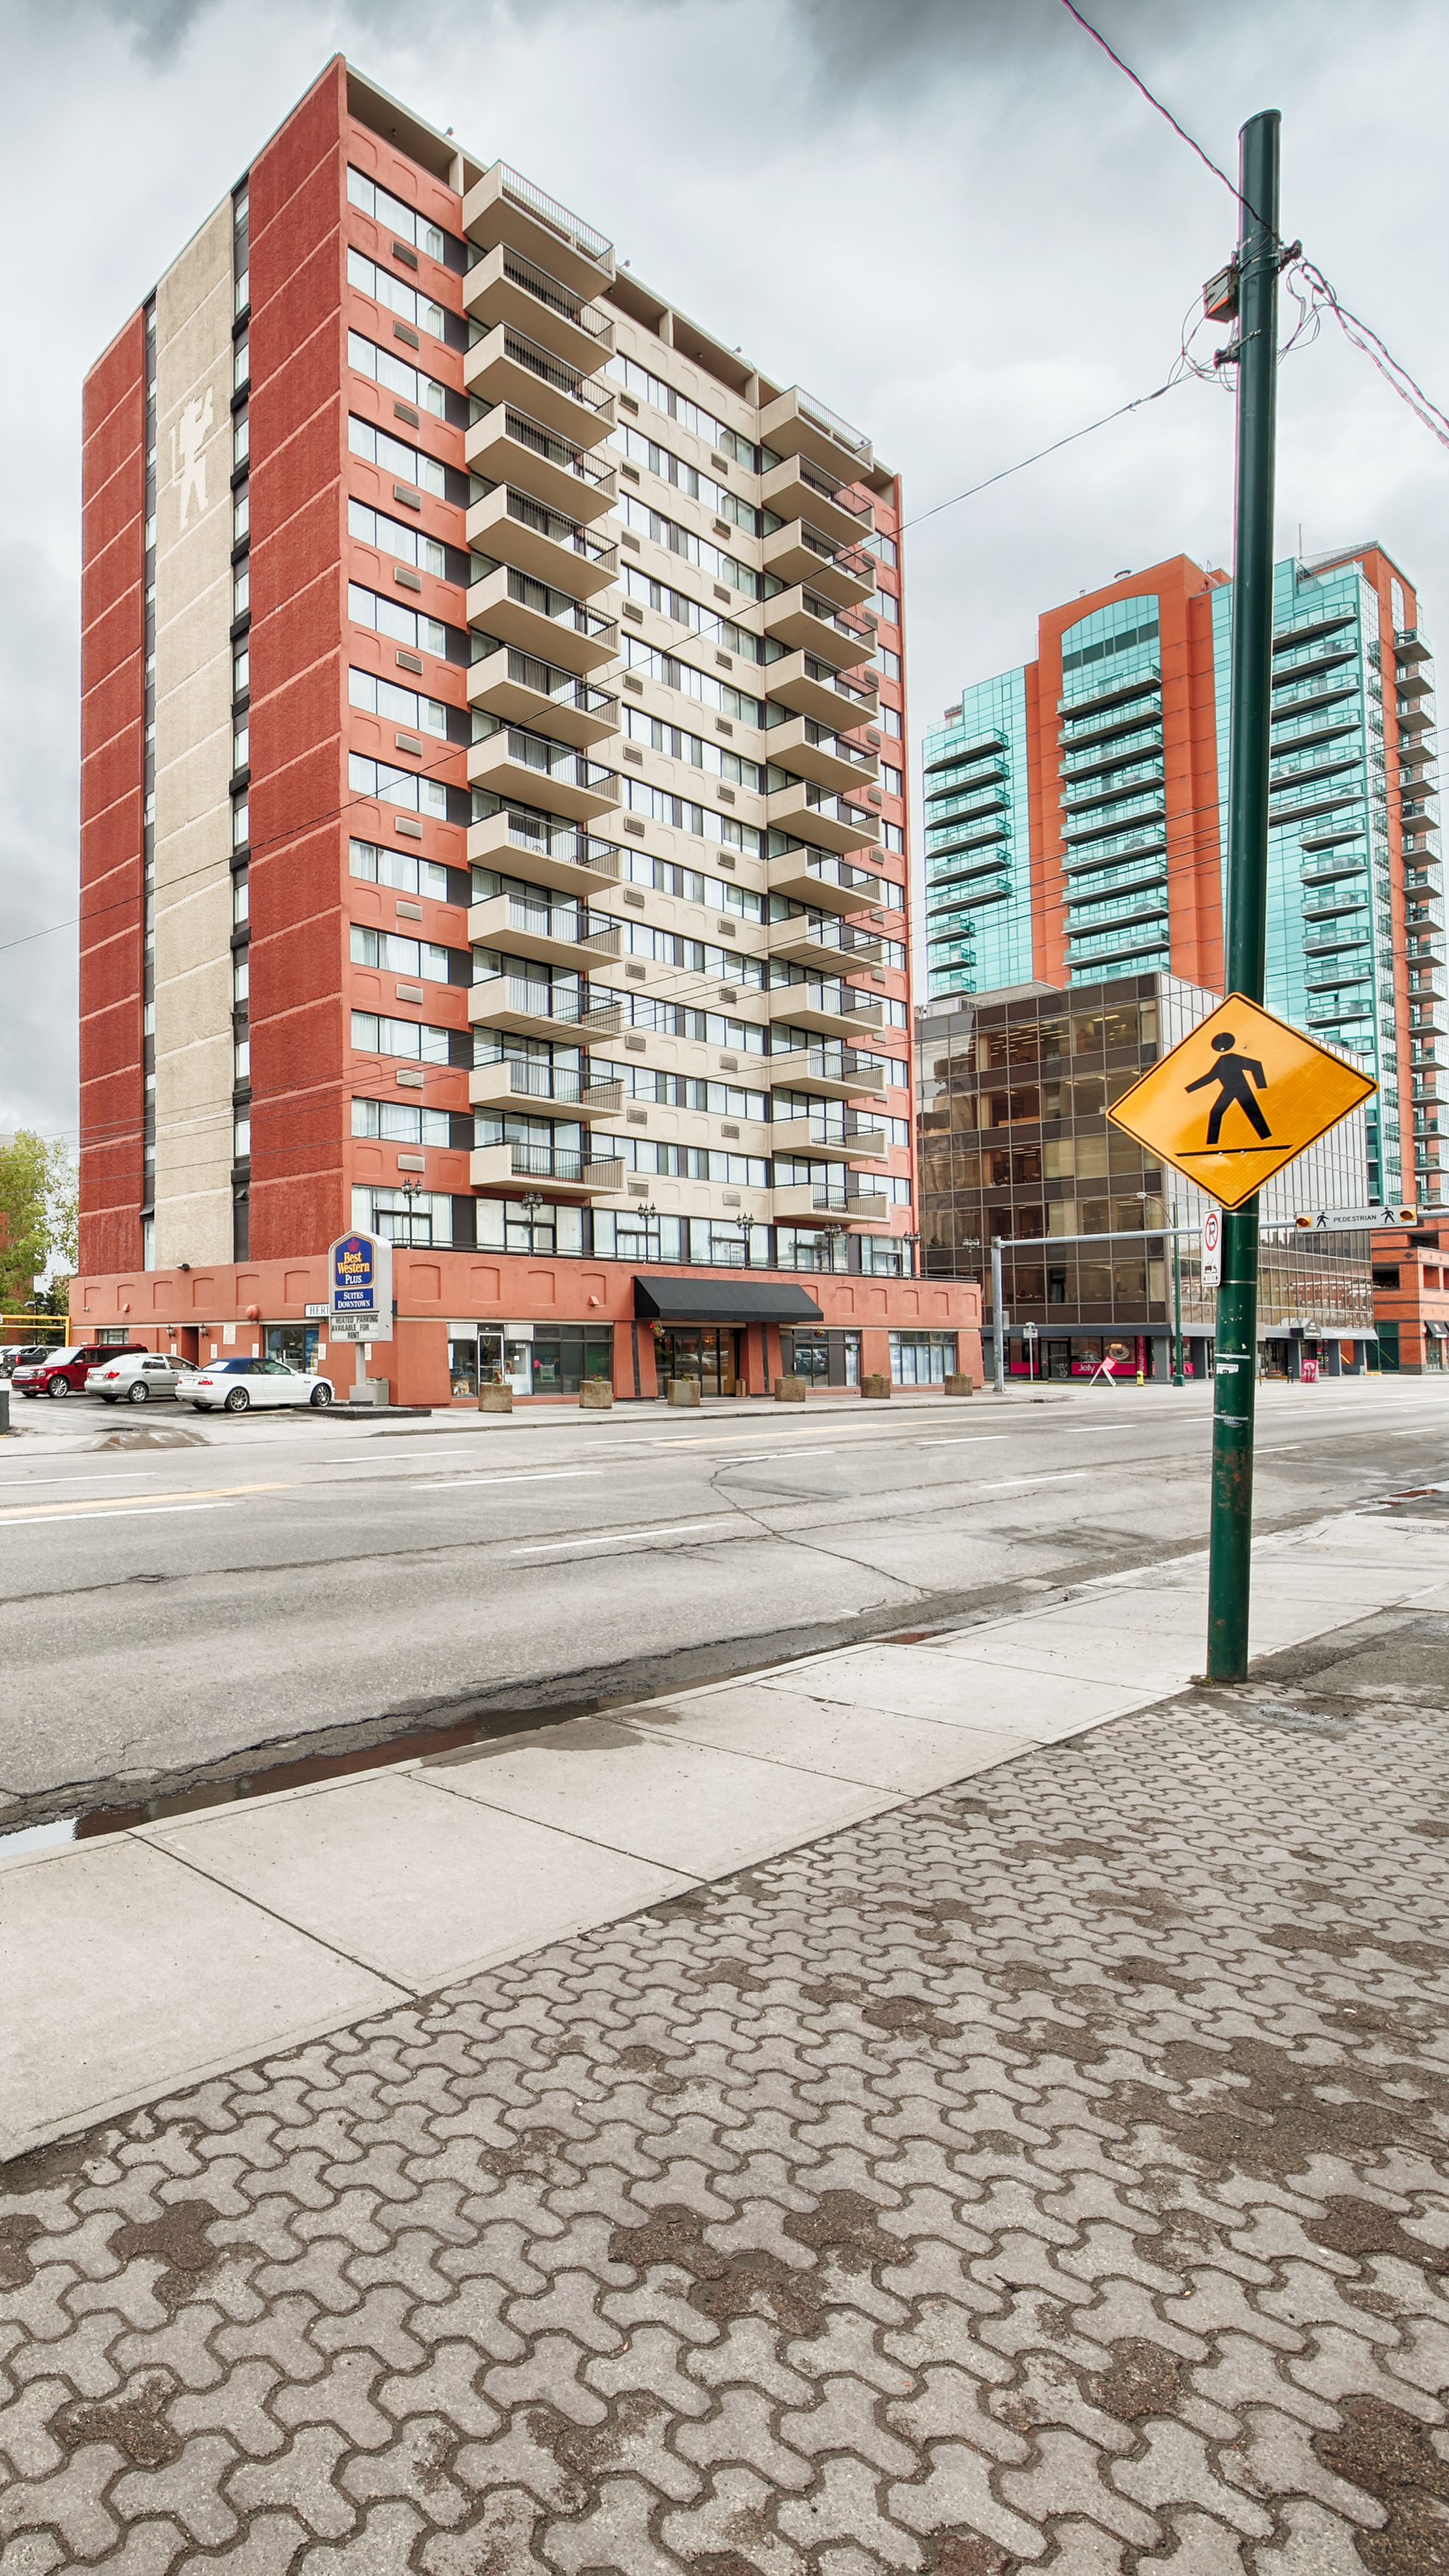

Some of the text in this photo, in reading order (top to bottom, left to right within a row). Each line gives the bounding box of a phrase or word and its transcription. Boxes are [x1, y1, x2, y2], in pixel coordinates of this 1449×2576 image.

[1333, 1214, 1377, 1222] PEDESTRIAN
[344, 1251, 362, 1263] Best
[337, 1262, 370, 1274] Western
[345, 1274, 362, 1284] PLUS
[343, 1292, 364, 1300] SUITES
[338, 1300, 370, 1309] DOWNTOWN
[356, 1314, 378, 1323] PARKING
[1078, 1364, 1095, 1373] Jelly
